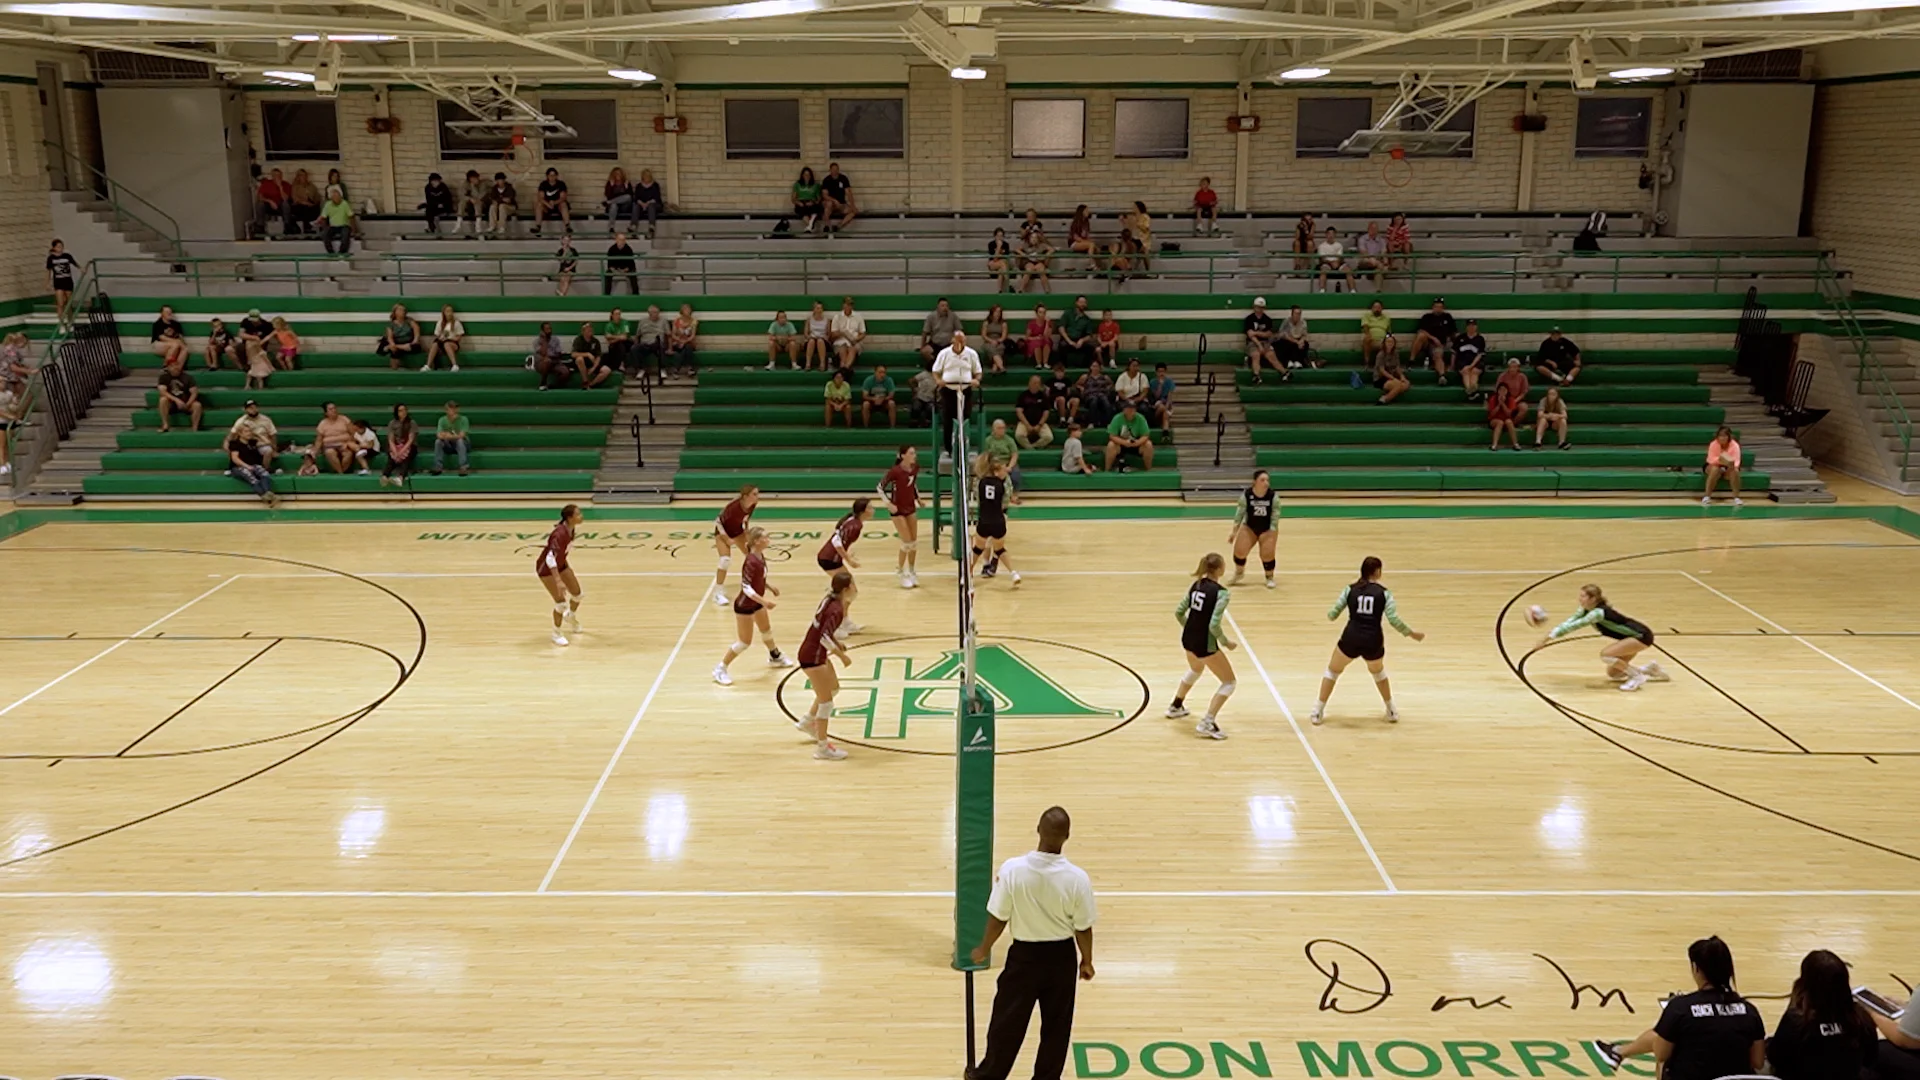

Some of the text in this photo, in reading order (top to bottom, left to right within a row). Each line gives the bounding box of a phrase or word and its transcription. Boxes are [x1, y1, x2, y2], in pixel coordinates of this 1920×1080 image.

[985, 484, 996, 500] 6
[417, 531, 823, 541] MOIS GYMASIUM
[1190, 590, 1207, 612] 15
[1356, 595, 1375, 615] 10
[1072, 1041, 1273, 1079] DON
